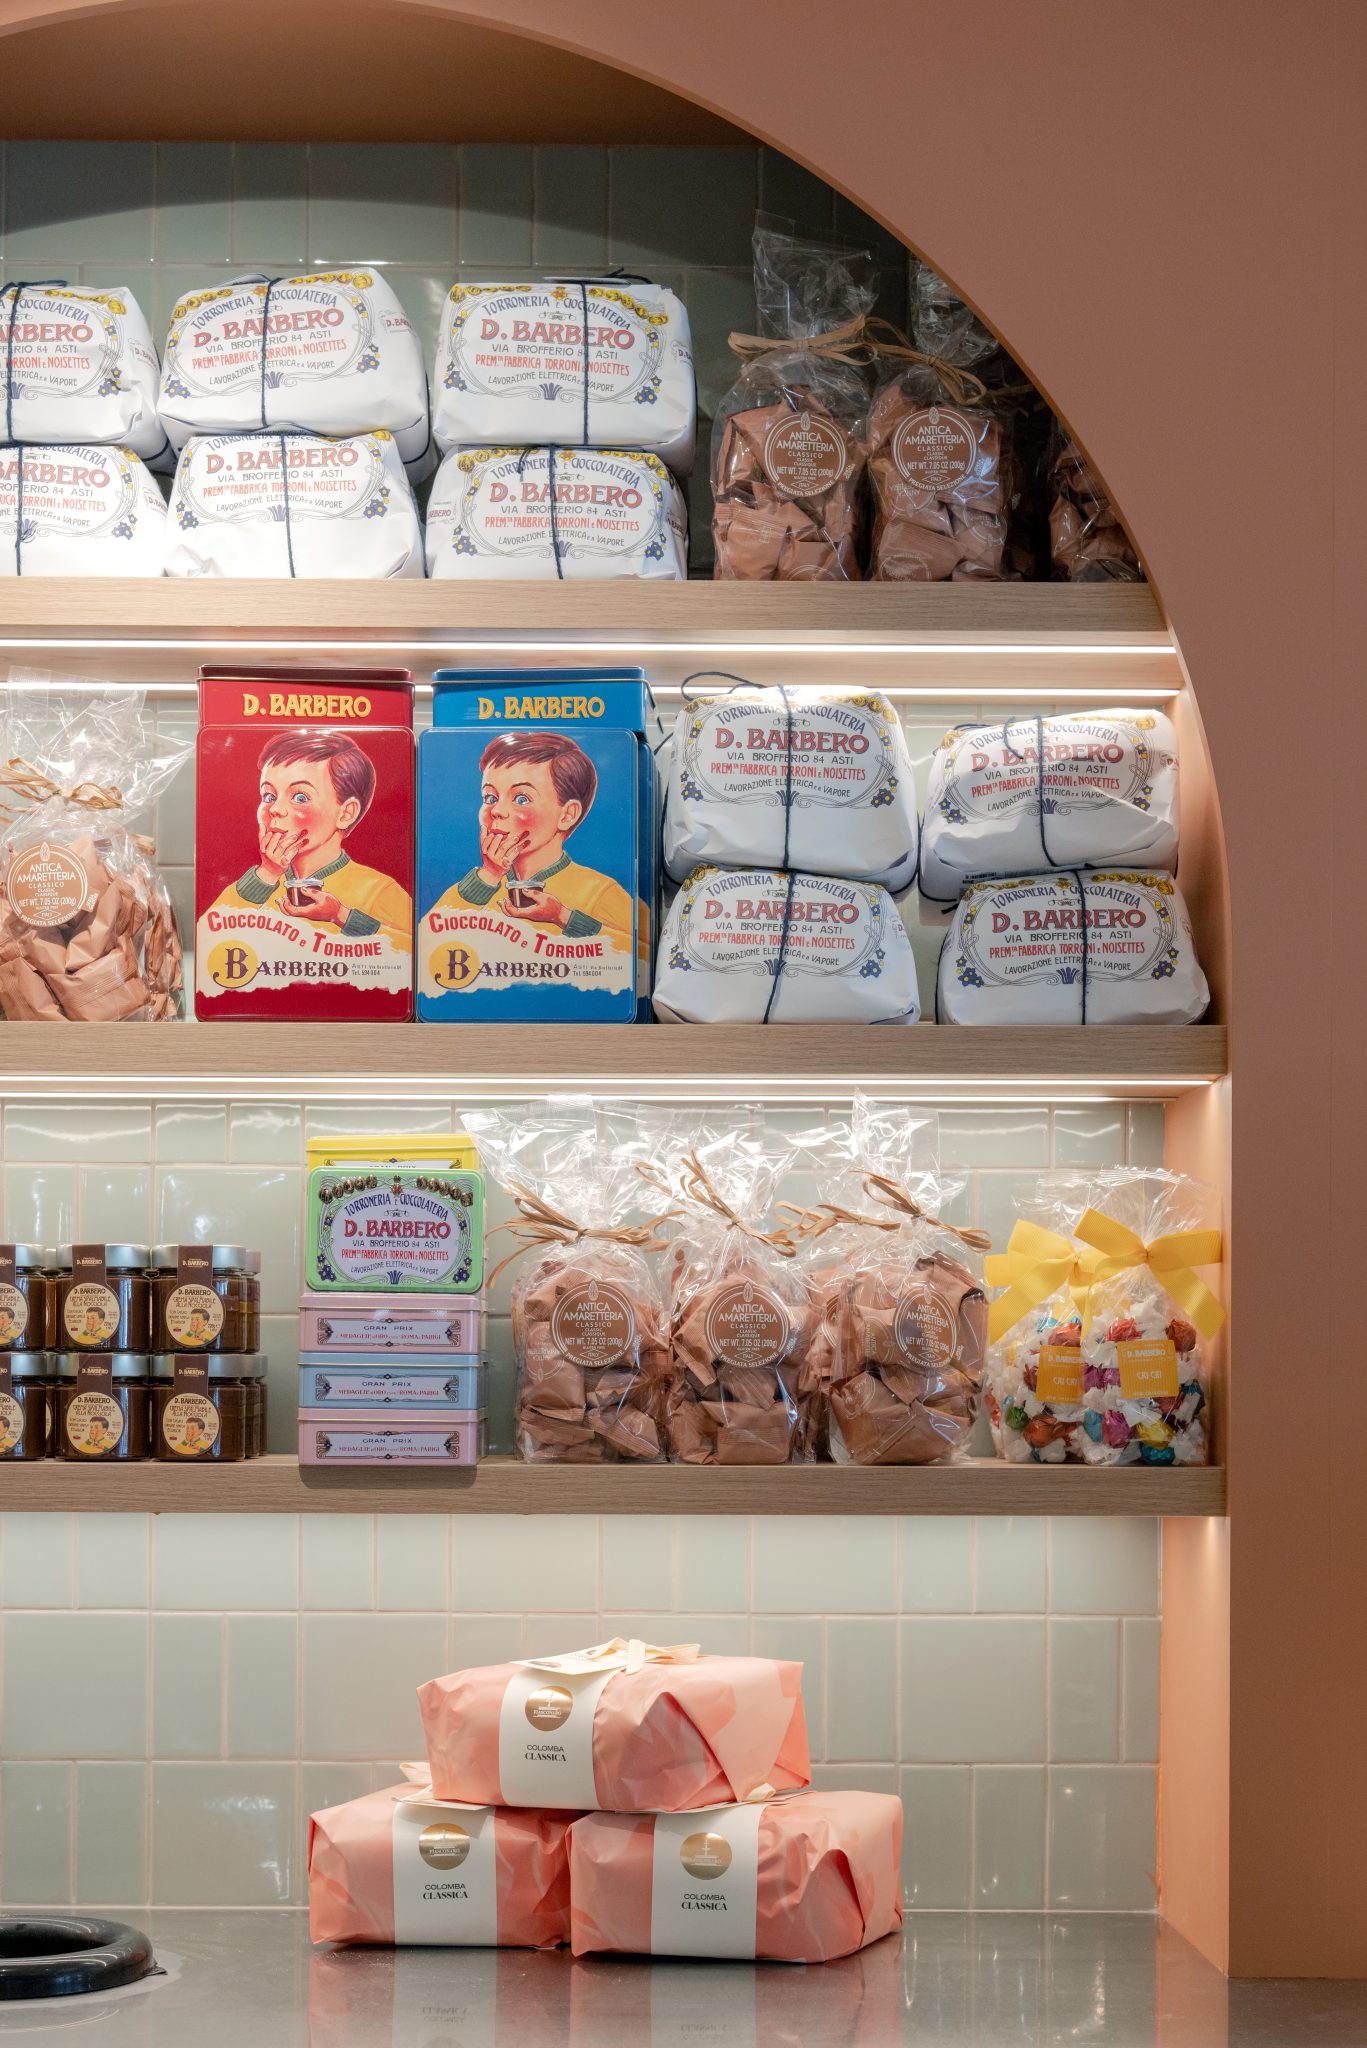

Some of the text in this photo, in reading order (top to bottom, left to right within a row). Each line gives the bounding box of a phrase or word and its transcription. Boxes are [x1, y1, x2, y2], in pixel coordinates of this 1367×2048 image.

[19, 299, 89, 324] CIOCCOLATERIA
[191, 296, 254, 329] TORRONERIA
[482, 296, 549, 316] TORRONERIA
[193, 308, 344, 347] D. BARBERO
[480, 319, 635, 349] D. BARBERO
[205, 330, 331, 353] VIA ASTI
[221, 339, 347, 366] FABBRICA NOISETTES
[492, 343, 618, 360] VIA BROFFERIO ASTI
[49, 357, 90, 369] NOISETTES
[504, 355, 629, 376] FABBRICA TORRONI NOISETTES
[488, 372, 577, 384] LAVORAZIONE ELETTRICA
[790, 432, 822, 441] ANTICA
[918, 426, 951, 434] ANTICA
[777, 440, 834, 452] AMARETTERIA
[905, 435, 965, 445] AMARETTERIA
[206, 454, 232, 474] D.
[908, 462, 917, 470] NET
[941, 461, 948, 469] OZ
[217, 474, 235, 483] VIA
[571, 458, 641, 488] CIOCCOLATERIA
[71, 488, 93, 496] ASTI
[231, 480, 357, 494] FABBRICA NOISETTES
[490, 483, 516, 502] D.
[63, 498, 106, 511] NOISETTES
[501, 506, 626, 518] VIA ASTI
[514, 517, 639, 531] FABBRICA NOISETTES
[597, 536, 624, 546] VAPORE
[243, 693, 371, 717] D. BARBERO
[478, 696, 605, 719] D. BARBERO
[715, 728, 869, 754] D. BARBERO
[1048, 725, 1119, 743] CIOCCOLATERIA
[727, 752, 853, 765] VIA BROFFERIO 84 ASTI
[740, 763, 866, 781] FABBRICA NOISETTES
[985, 765, 1108, 781] VIA ASTI
[724, 779, 850, 797] LAVORAZIONE VAPORE
[999, 776, 1119, 792] FABBRICA NOISETTES
[30, 863, 62, 872] ANTICA
[17, 872, 75, 883] AMARETTERIA
[706, 875, 773, 897] TORRONERIA
[990, 887, 1057, 910] TORRONERIA
[705, 900, 860, 924] D. BARBERO
[716, 922, 842, 934] VIA ASTI
[992, 909, 1147, 933] D. BARBERO
[207, 911, 382, 957] CIOCCOLATO e TORRONE
[429, 913, 603, 958] CIOCCOLATO e TORRONE
[728, 933, 855, 949] FABBRICA NOISETTES
[1005, 931, 1131, 944] VIA ASTI
[1018, 942, 1145, 956] FABBRICA NOISETTES
[812, 955, 839, 965] VAPORE
[1004, 957, 1131, 974] LAVORAZIONE VAPORE
[213, 948, 349, 989] BARBERO
[435, 949, 571, 989] BARBERO
[344, 1194, 391, 1216] TORRONERIA
[400, 1194, 449, 1221] CIOCCOLATERIA
[344, 1220, 451, 1239] D. BARBERO
[361, 1250, 448, 1260] FABBRICA TORRONI NOISETTES
[351, 1262, 384, 1272] LAVORAZIONE
[420, 1266, 438, 1274] VAPORE
[577, 1302, 610, 1311] ANTICA
[732, 1304, 764, 1312] ANTICA
[917, 1304, 940, 1315] ANTICA
[564, 1312, 623, 1320] AMARETTERIA
[719, 1314, 777, 1322] AMARETTERIA
[906, 1311, 949, 1328] AMARETTERIA
[525, 1753, 566, 1761] CLASSICA
[423, 1891, 468, 1899] CLASSICA
[681, 1902, 727, 1910] CLASSICA
